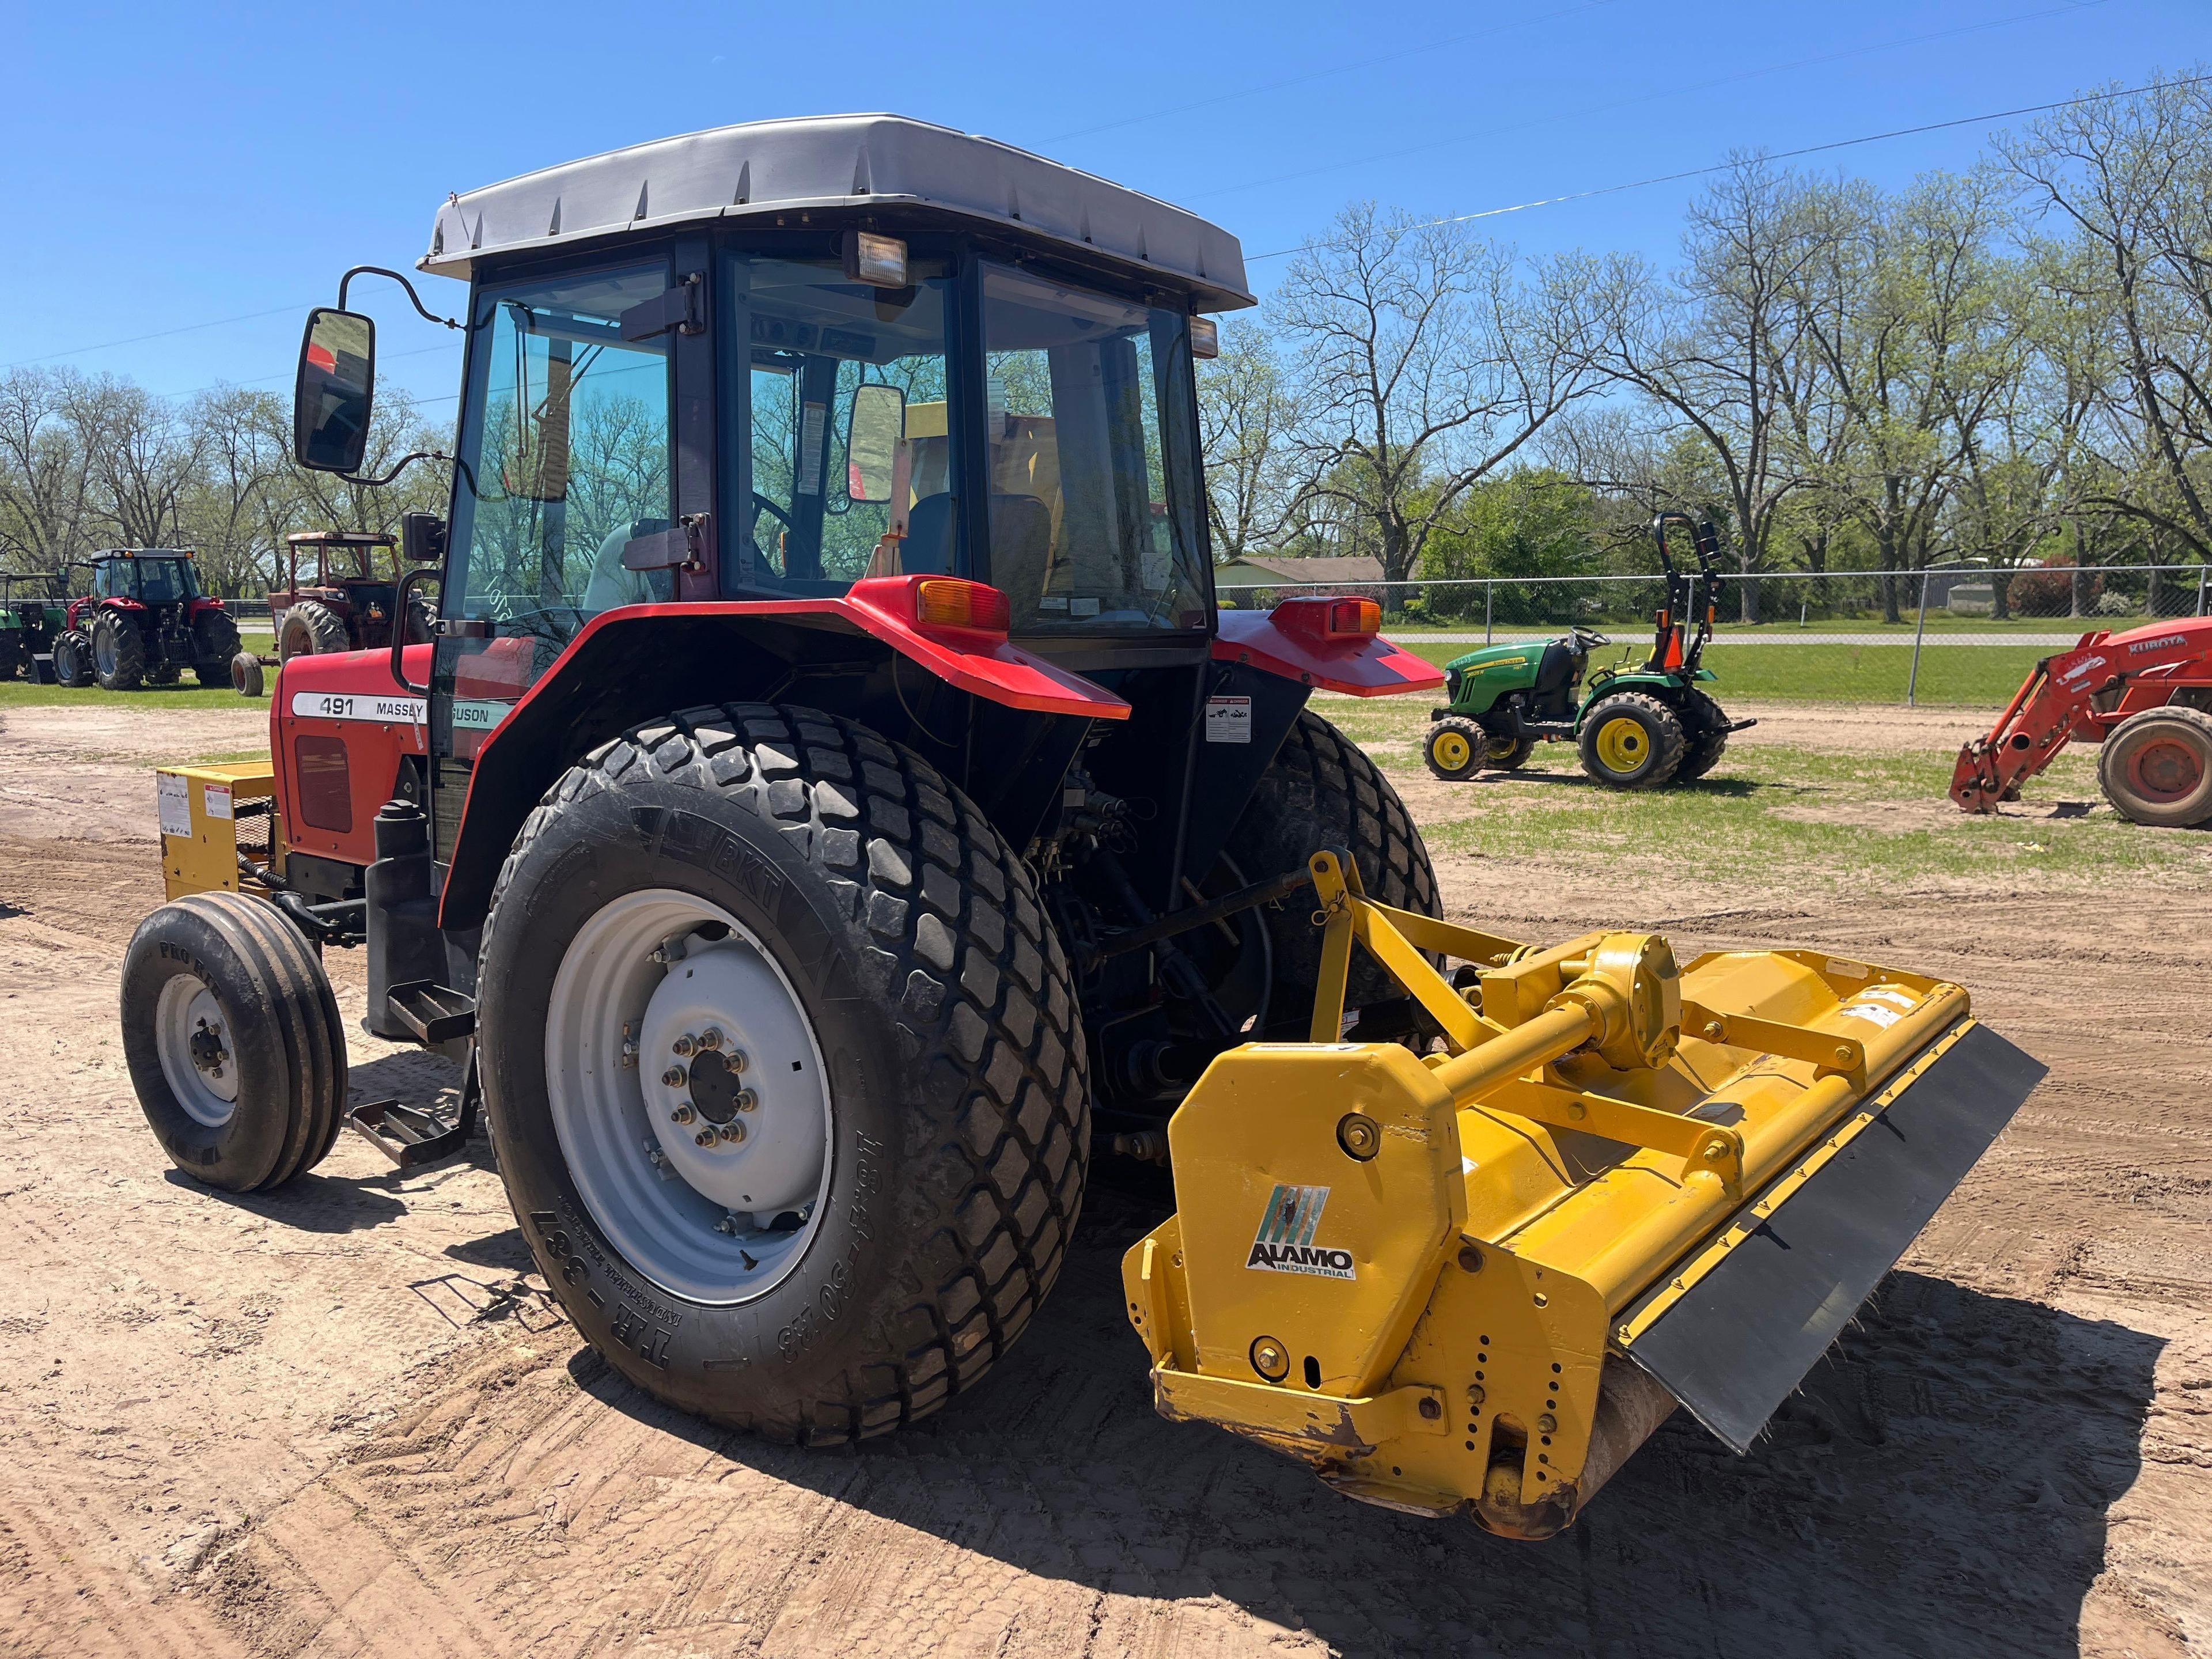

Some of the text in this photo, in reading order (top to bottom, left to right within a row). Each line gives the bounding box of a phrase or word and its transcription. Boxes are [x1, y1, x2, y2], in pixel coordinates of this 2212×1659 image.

[2128, 635, 2187, 654] KUBOTA
[320, 697, 488, 722] 491 MASSEY GUSON
[715, 837, 782, 910] BKT
[1247, 1243, 1353, 1270] ALAMO
[1277, 1263, 1351, 1279] INDUSTRIAL
[604, 1261, 683, 1327] INDUSTRIAL
